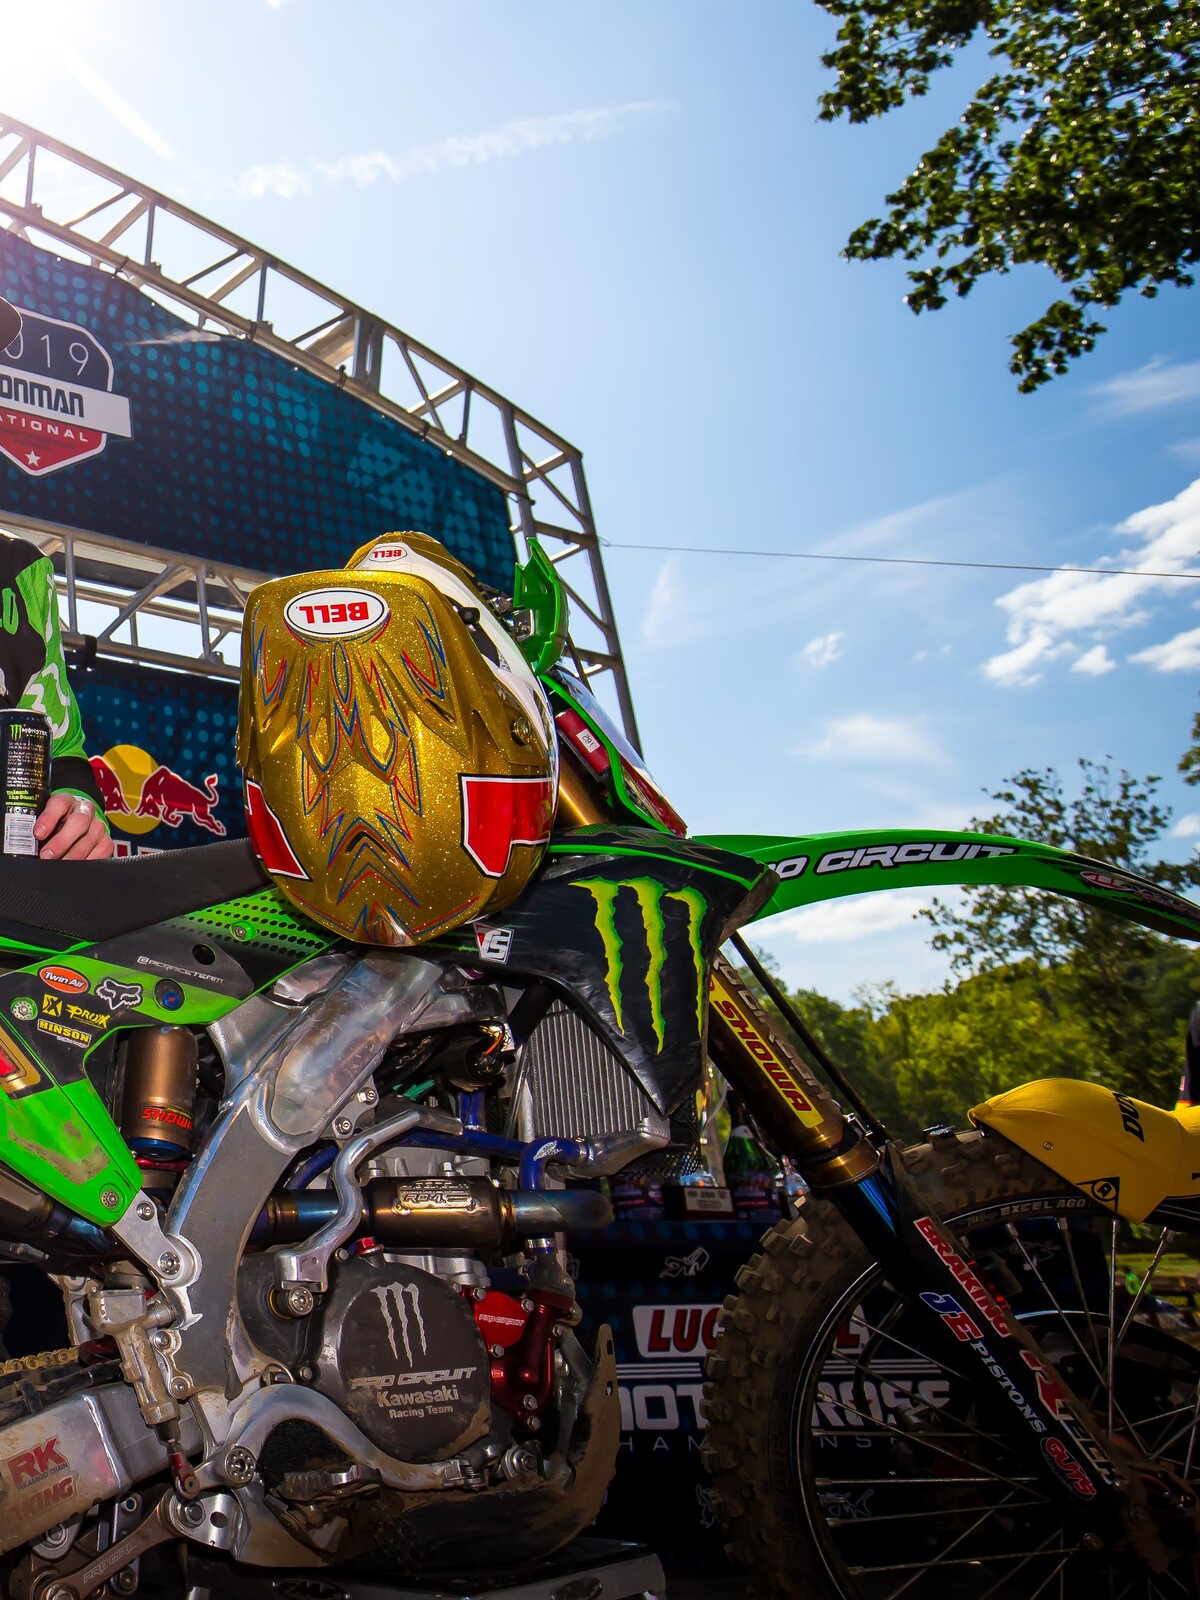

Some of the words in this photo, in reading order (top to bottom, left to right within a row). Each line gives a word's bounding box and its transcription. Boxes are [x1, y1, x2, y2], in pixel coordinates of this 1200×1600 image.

[371, 548, 404, 559] BELL
[298, 600, 370, 624] BELL
[816, 842, 1018, 875] CIRCUIT
[44, 971, 69, 985] Twin
[69, 978, 86, 988] Air
[38, 1019, 91, 1043] HINSON
[713, 999, 813, 1112] SHOWA
[1000, 1199, 1054, 1217] EXCEL
[1056, 1198, 1087, 1209] A60
[912, 1215, 1013, 1338] BRAKING
[494, 1316, 525, 1327] CIRCUIT
[918, 1291, 983, 1343] JE
[970, 1338, 1048, 1434] PISTONS
[351, 1374, 396, 1390] PRO
[398, 1366, 478, 1385] CIRCUIT
[376, 1384, 460, 1408] Kawasaki
[388, 1407, 425, 1419] Racing
[426, 1404, 454, 1415] Team
[7, 1435, 68, 1485] RK
[48, 1461, 69, 1476] CHAIN
[1044, 1437, 1098, 1499] GUTS
